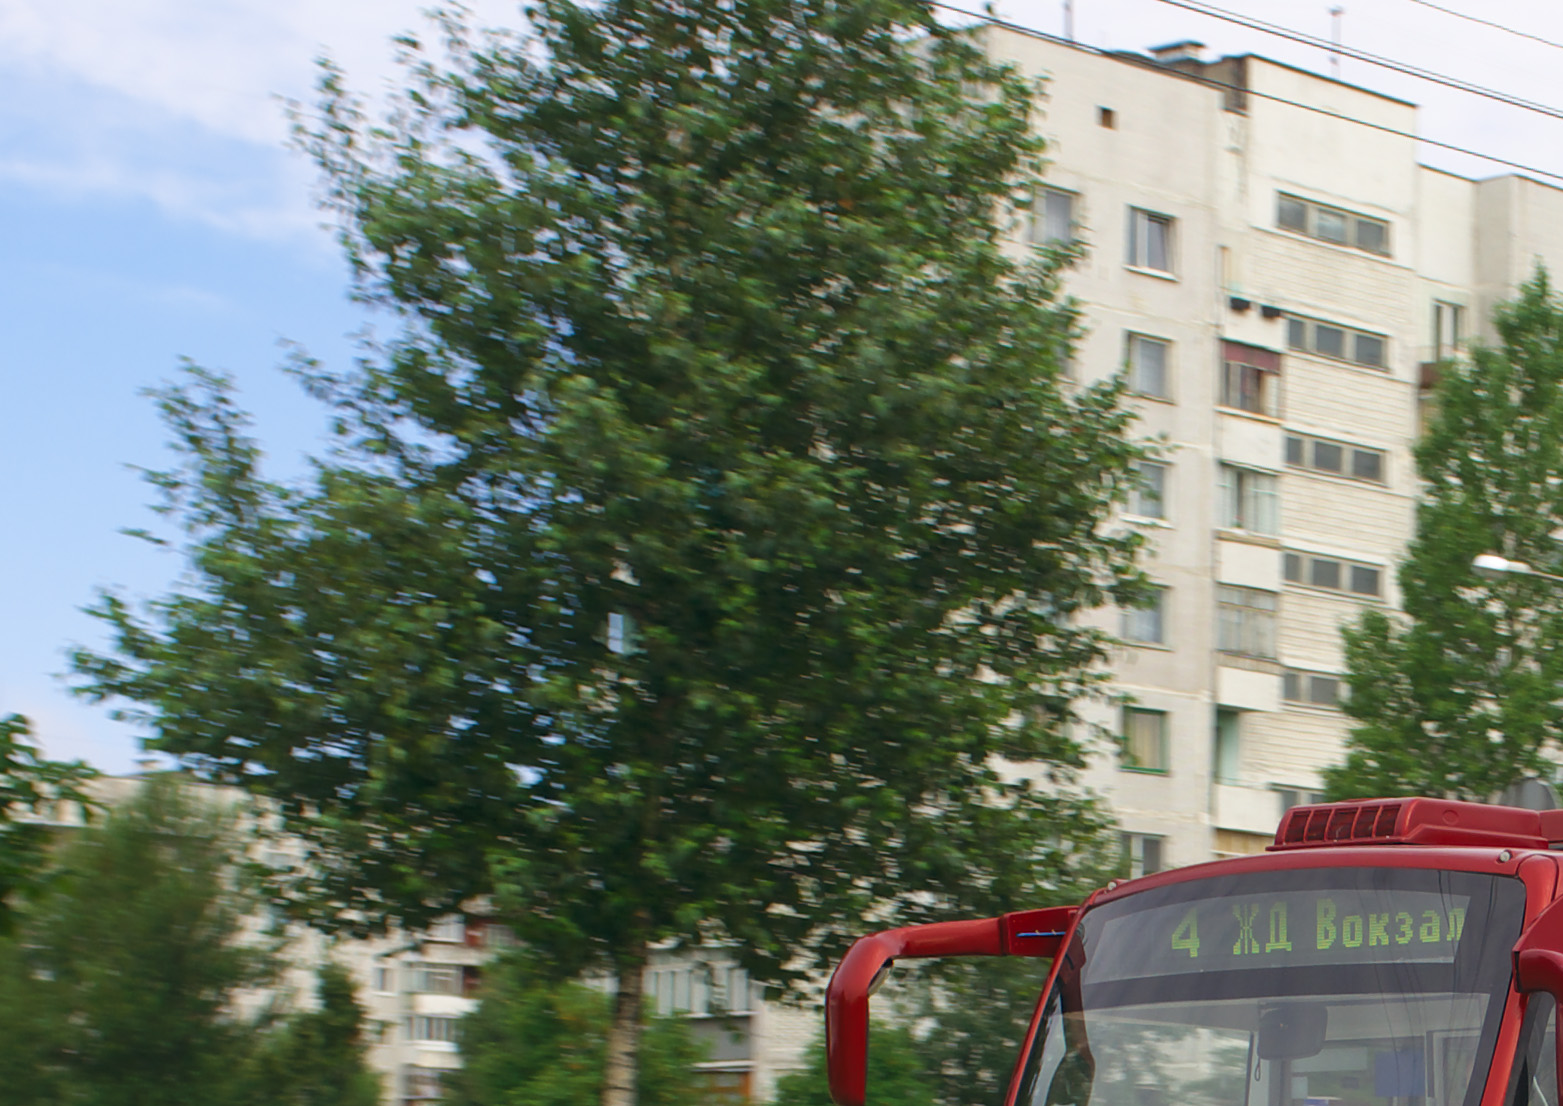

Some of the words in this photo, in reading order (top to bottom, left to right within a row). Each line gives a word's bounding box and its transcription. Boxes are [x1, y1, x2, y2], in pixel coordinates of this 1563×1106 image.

[1171, 904, 1200, 958] 4
[1232, 902, 1292, 955] ЖД
[1316, 899, 1465, 950] Вокзал
